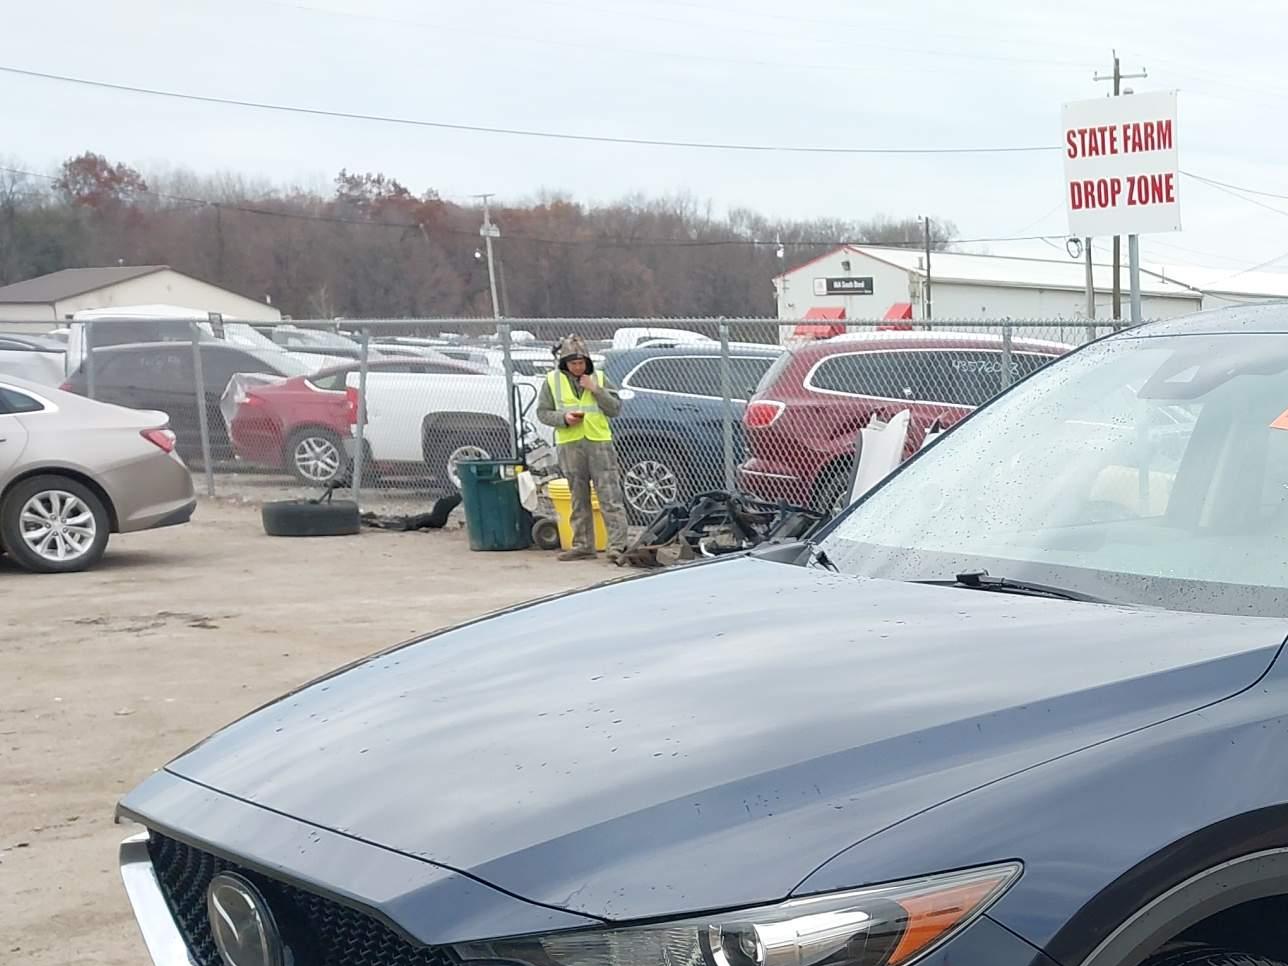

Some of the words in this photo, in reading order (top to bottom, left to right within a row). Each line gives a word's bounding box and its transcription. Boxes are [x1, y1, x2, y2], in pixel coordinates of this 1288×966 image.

[1066, 125, 1118, 159] STATE
[1122, 119, 1172, 153] FARM
[1070, 178, 1121, 210] DROP
[1126, 173, 1175, 205] ZONE
